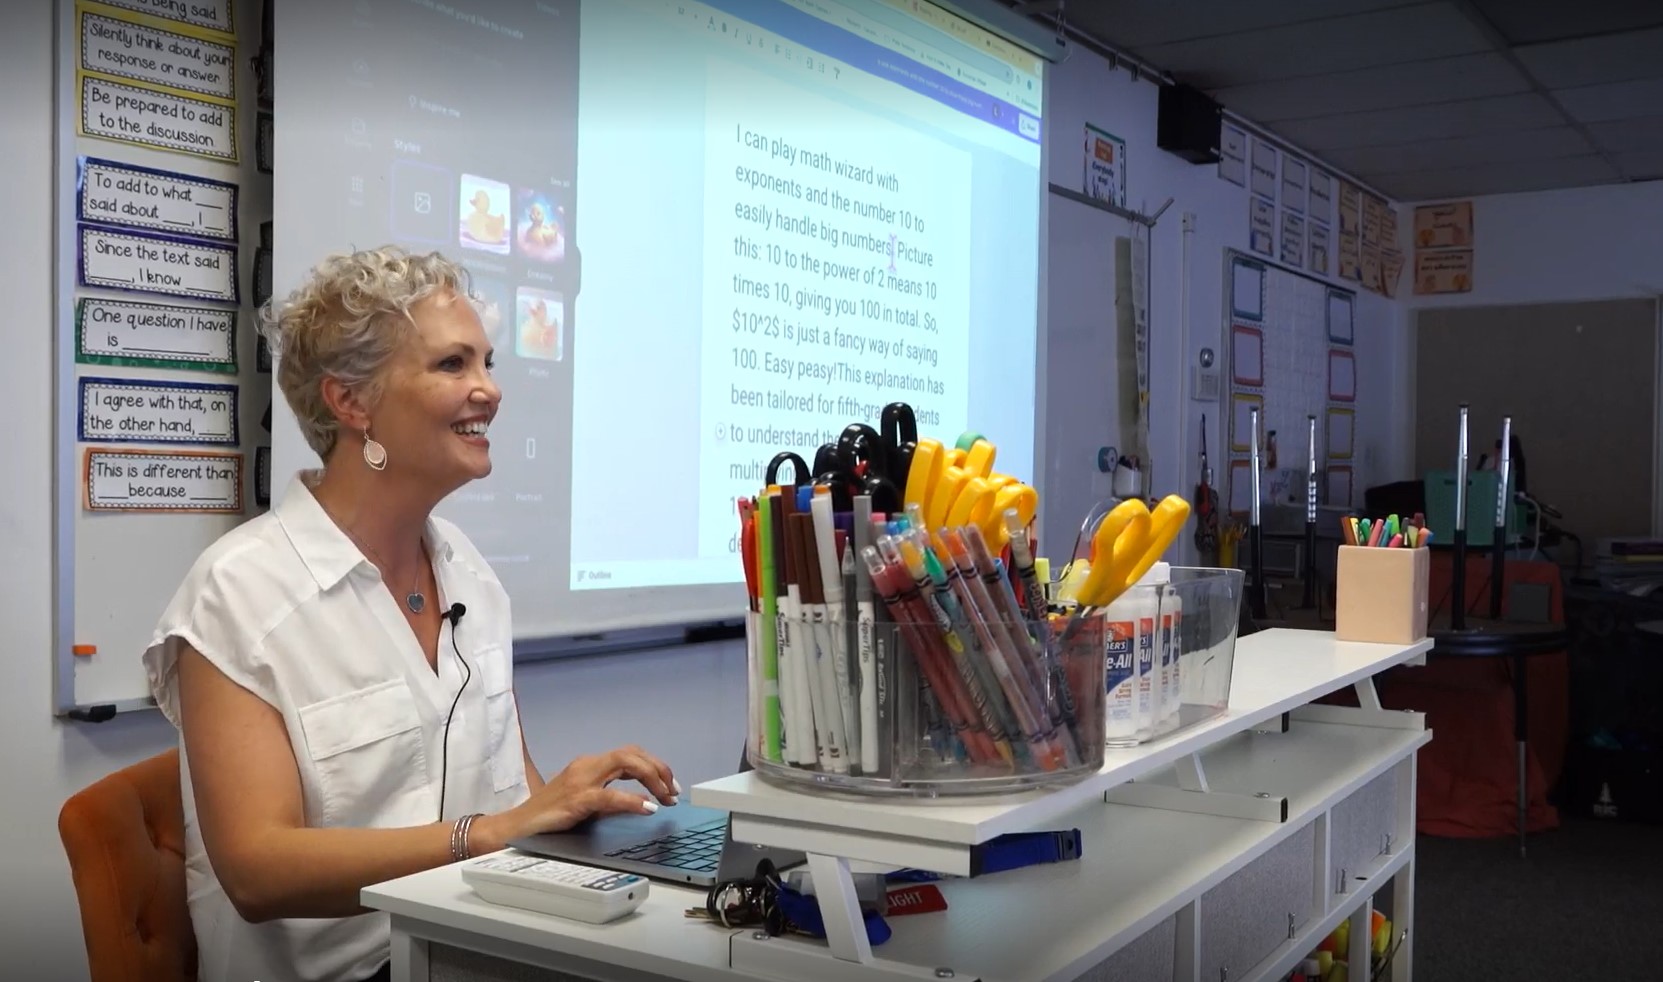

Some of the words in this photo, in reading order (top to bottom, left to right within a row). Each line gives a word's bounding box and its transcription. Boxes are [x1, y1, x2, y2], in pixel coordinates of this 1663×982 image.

[191, 5, 217, 20] said
[90, 23, 132, 48] Silently
[136, 33, 164, 52] think
[168, 42, 201, 60] about
[204, 54, 231, 66] your
[98, 49, 156, 70] response
[161, 62, 174, 73] or
[92, 87, 111, 104] Be
[116, 95, 178, 118] prepared
[182, 106, 195, 121] to
[199, 112, 223, 127] add
[99, 112, 115, 128] to
[118, 117, 141, 133] the
[736, 123, 741, 143] I
[744, 130, 768, 151] can
[772, 137, 797, 166] play
[800, 149, 832, 173] math
[835, 159, 874, 185] wizard
[877, 171, 899, 192] with
[94, 172, 112, 188] To
[116, 178, 141, 194] add
[144, 181, 159, 196] to
[162, 186, 192, 201] what
[735, 165, 802, 199] exponents
[806, 186, 828, 206] and
[831, 190, 850, 212] the
[853, 199, 896, 224] number
[899, 210, 912, 230] 10
[914, 217, 925, 233] to
[89, 198, 117, 212] said
[122, 201, 159, 219] about
[735, 202, 772, 231] easily
[776, 208, 817, 238] handle
[821, 220, 839, 248] big
[897, 241, 933, 267] Picture
[95, 239, 132, 257] Since
[136, 245, 159, 261] the
[163, 248, 190, 265] text
[194, 256, 220, 270] said
[734, 236, 761, 261] this:
[766, 243, 781, 265] 10
[785, 249, 797, 268] to
[801, 253, 820, 273] the
[823, 260, 859, 284] power
[863, 266, 876, 285] of
[878, 270, 885, 288] 2
[887, 276, 922, 297] means
[925, 281, 937, 300] 10
[147, 268, 182, 286] know
[733, 274, 770, 299] times
[775, 282, 792, 307] 10,
[796, 287, 832, 316] giving
[835, 297, 856, 318] you
[860, 298, 880, 320] 100
[883, 306, 892, 323] in
[895, 309, 920, 328] total.
[923, 312, 938, 335] So,
[92, 307, 122, 324] One
[127, 313, 186, 330] question
[189, 315, 194, 330] I
[197, 316, 227, 332] have
[107, 334, 119, 346] is
[732, 307, 779, 339] $10^2$
[783, 320, 794, 338] is
[797, 322, 820, 346] just
[823, 330, 830, 345] a
[834, 327, 866, 355] fancy
[869, 336, 890, 358] way
[892, 339, 903, 357] of
[906, 344, 938, 367] saying
[732, 347, 760, 371] 100.
[765, 352, 795, 380] Easy
[864, 368, 926, 392] explanation
[927, 375, 944, 395] has
[95, 391, 99, 406] I
[103, 395, 144, 412] agree
[149, 395, 175, 410] with
[178, 396, 207, 414] that,
[211, 399, 226, 411] on
[731, 384, 764, 408] been
[767, 389, 814, 413] tailored
[817, 393, 834, 414] for
[90, 416, 113, 430] the
[119, 417, 155, 431] other
[159, 418, 195, 435] hand,
[730, 424, 743, 442] to
[748, 427, 819, 448] understand
[96, 462, 123, 478] This
[127, 464, 138, 477] is
[143, 464, 202, 480] different
[206, 466, 234, 480] than
[129, 483, 186, 497] because
[863, 617, 873, 664] SuperTips
[1107, 654, 1131, 669] e-All
